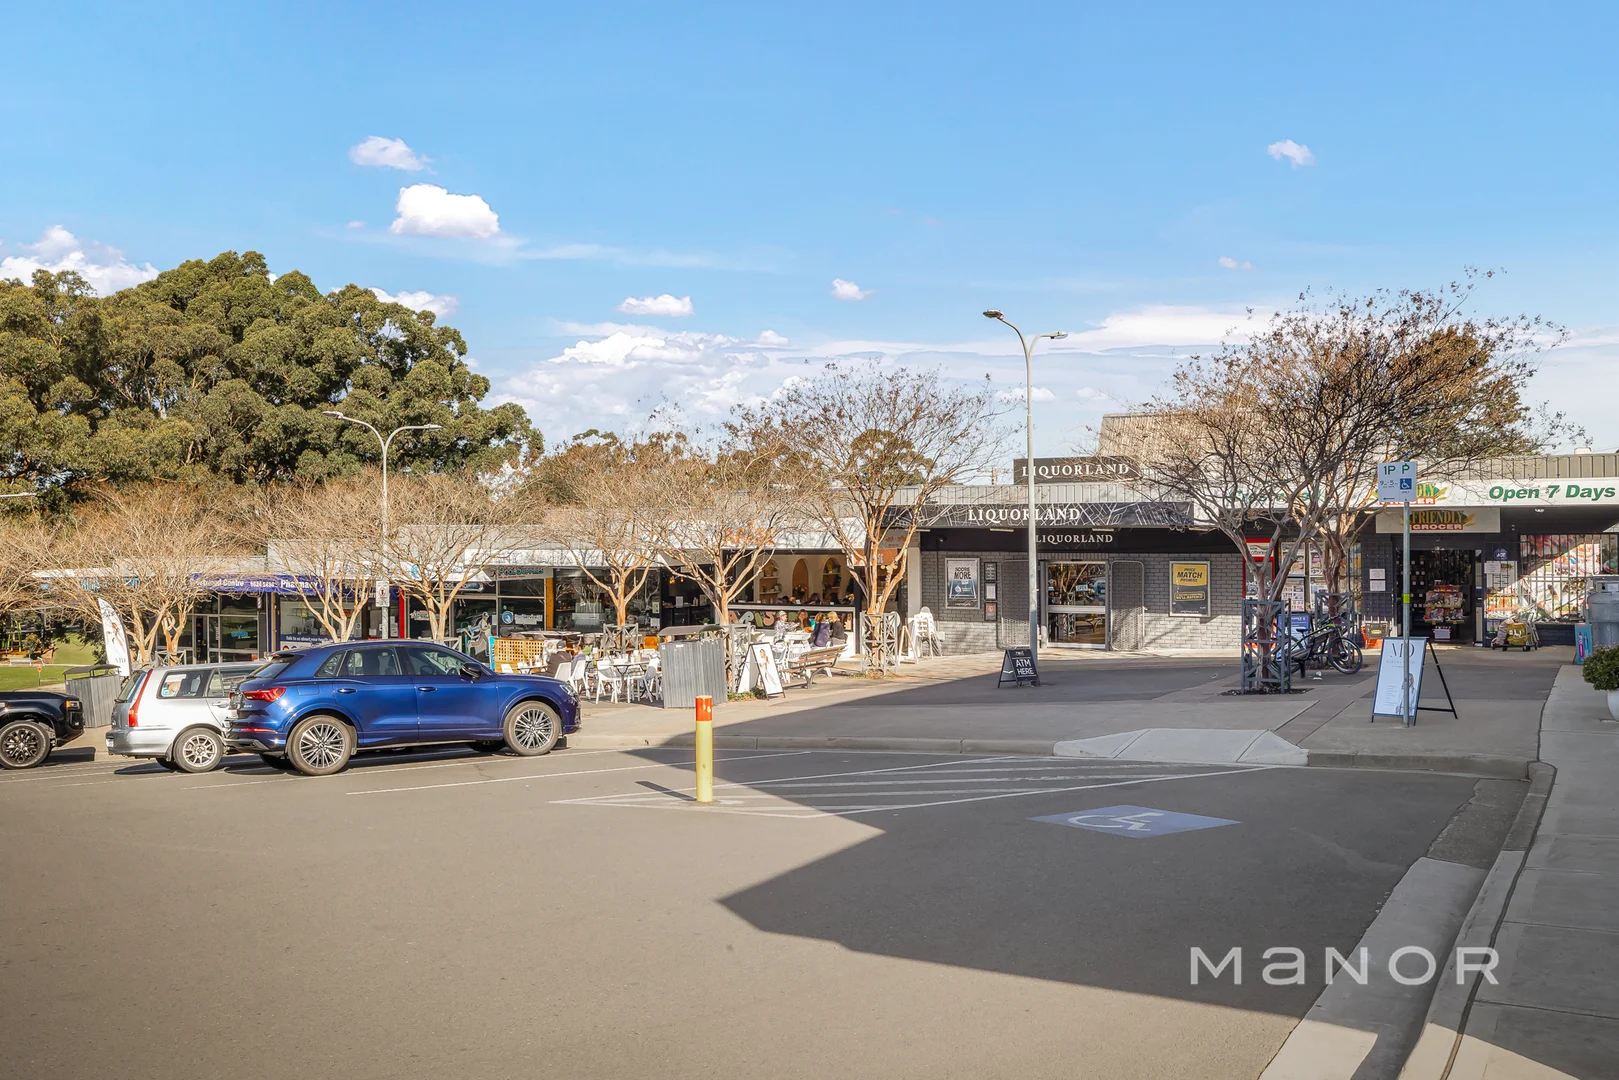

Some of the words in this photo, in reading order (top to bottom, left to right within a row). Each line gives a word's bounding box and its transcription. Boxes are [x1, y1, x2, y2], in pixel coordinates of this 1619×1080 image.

[1022, 463, 1129, 479] LIQUORLAND
[1383, 465, 1396, 475] 1P
[1489, 485, 1540, 502] Open
[1548, 485, 1560, 498] 7
[1566, 484, 1616, 501] Days
[968, 508, 1080, 524] LIQUORLAND
[1412, 511, 1464, 524] FRIENDLY
[1036, 534, 1113, 545] LIQUORLAND
[954, 571, 972, 579] MORE
[1016, 659, 1031, 667] ATM
